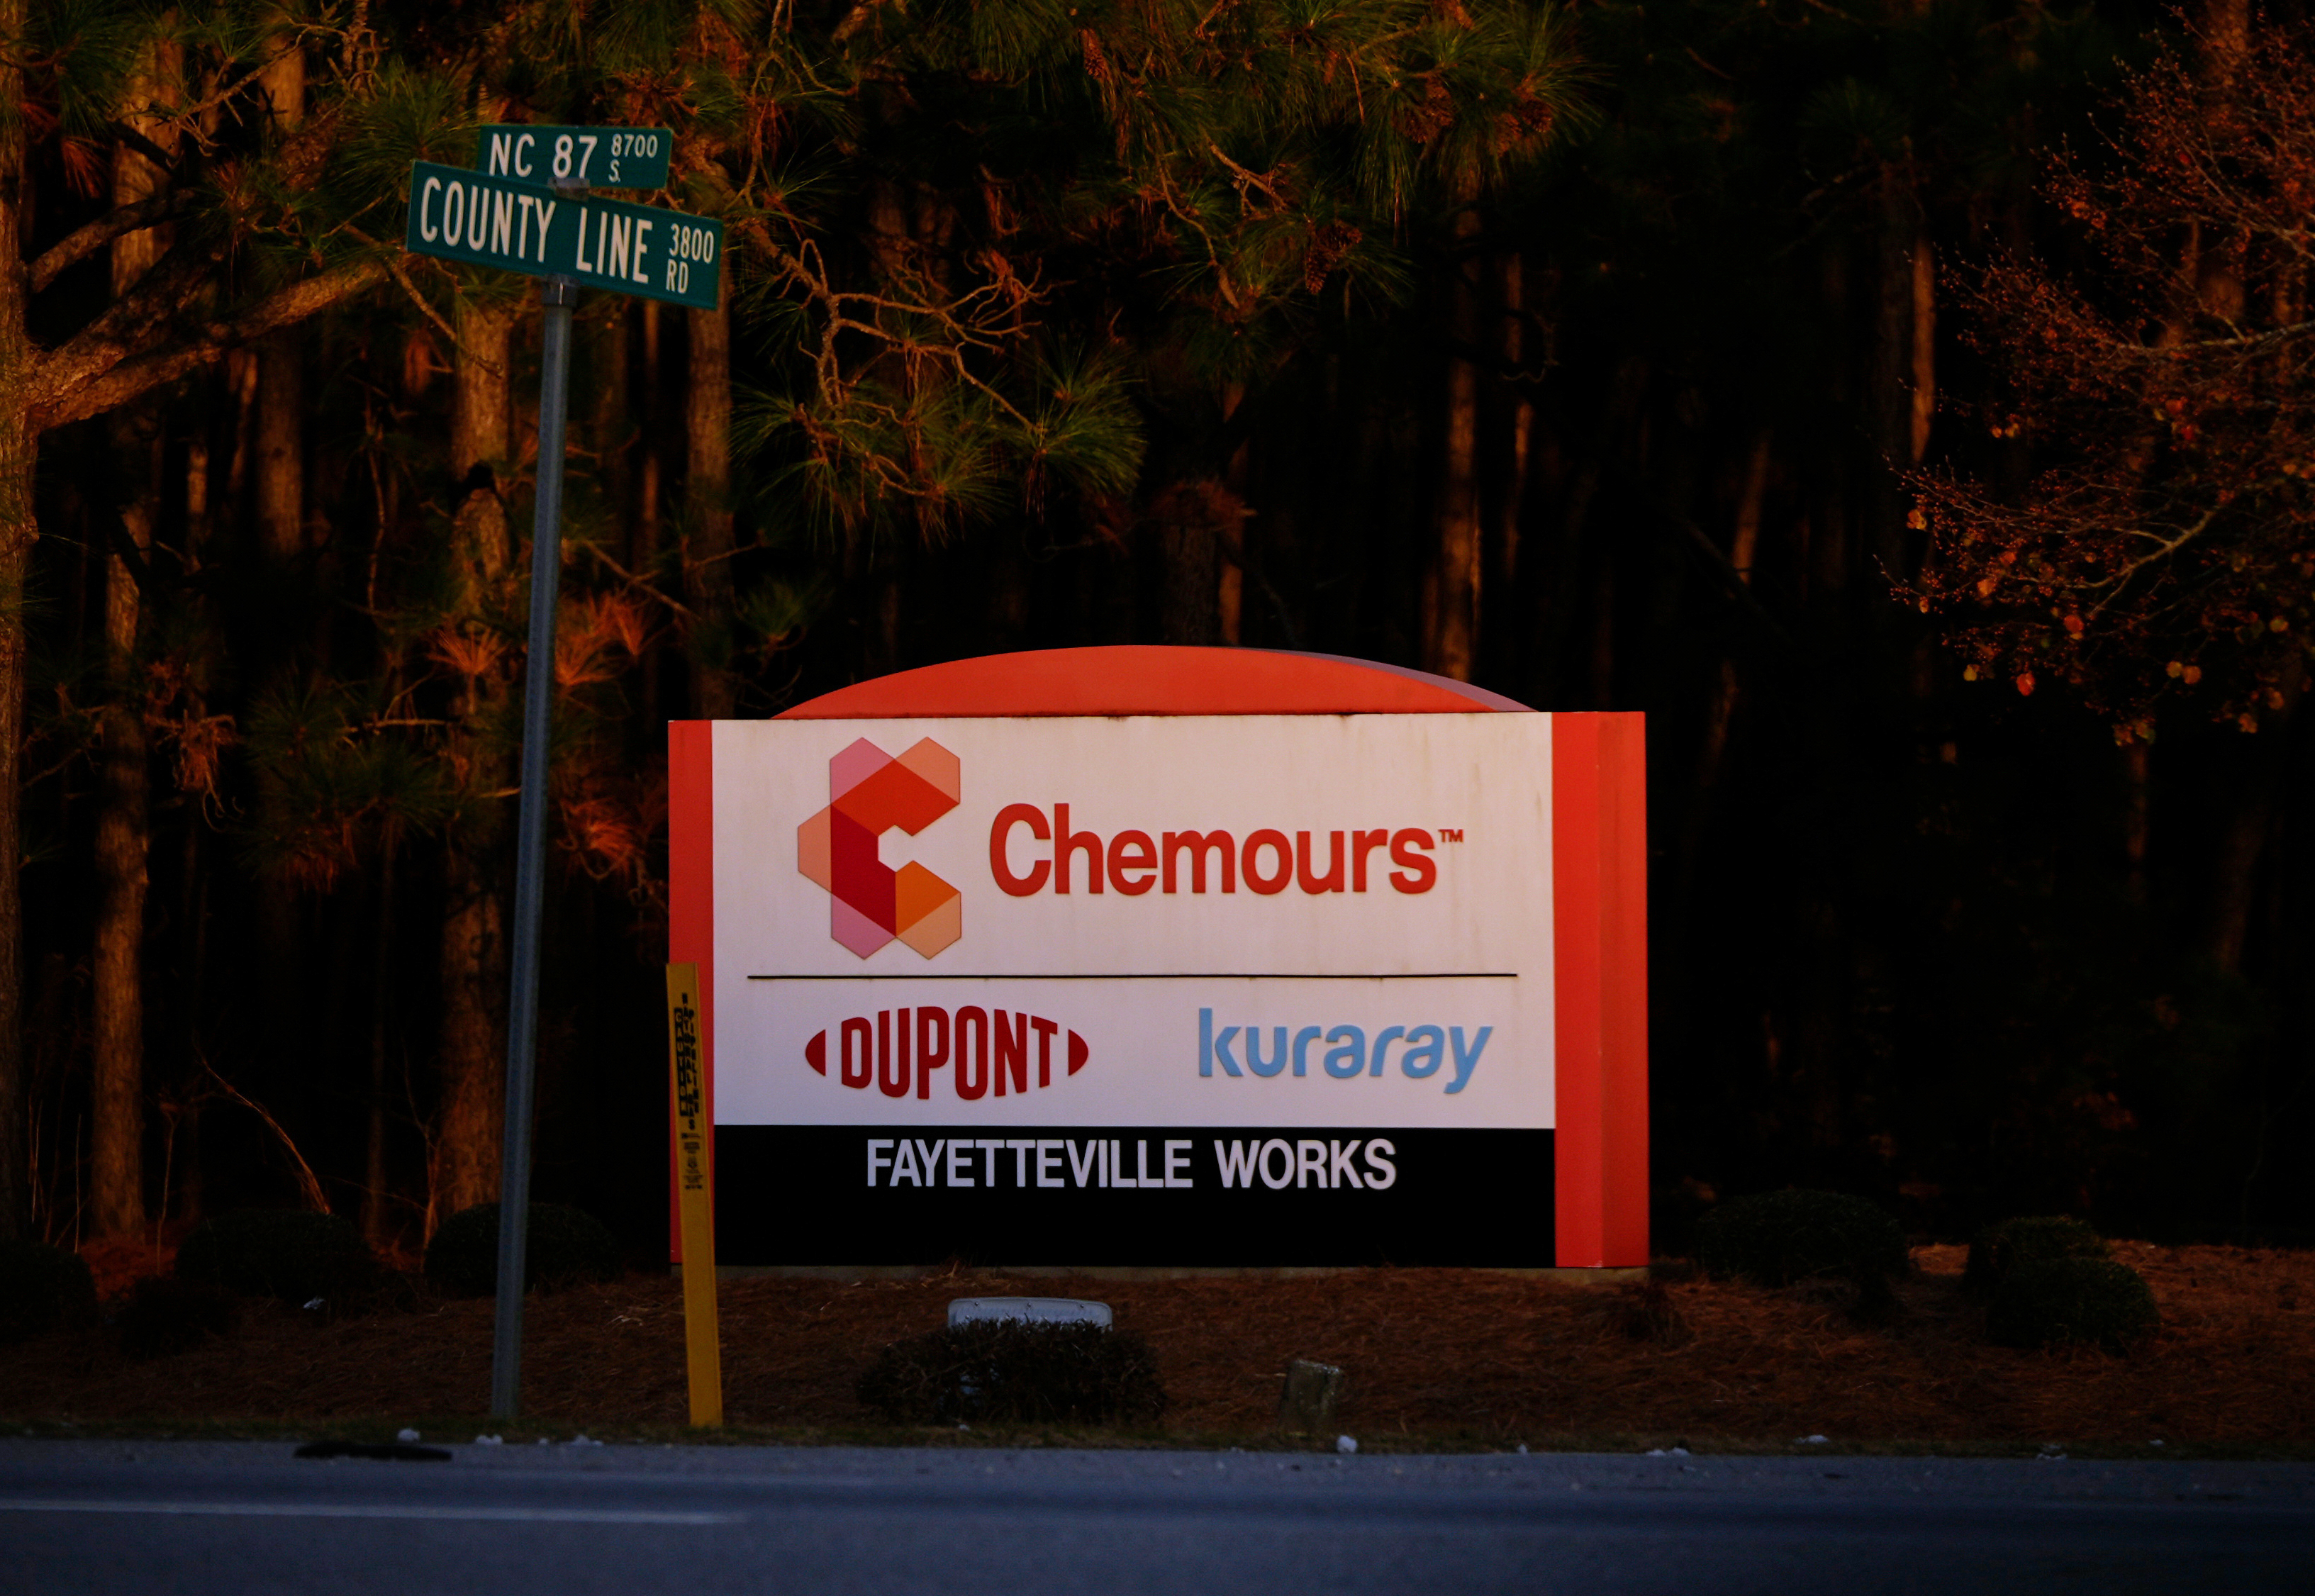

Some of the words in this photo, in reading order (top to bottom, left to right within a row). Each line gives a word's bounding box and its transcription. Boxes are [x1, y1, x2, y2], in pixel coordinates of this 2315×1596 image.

[489, 133, 535, 177] NC
[552, 133, 598, 179] 87
[610, 133, 658, 159] 8700
[420, 176, 557, 263] COUNTY
[575, 206, 653, 284] LINE
[669, 223, 715, 264] 3800
[665, 258, 689, 294] RD
[841, 1005, 1059, 1100] DUPONT
[1198, 1008, 1493, 1094] kuraray
[866, 1138, 1193, 1188] FAYETTEVILLE
[1214, 1139, 1397, 1190] WORKS
